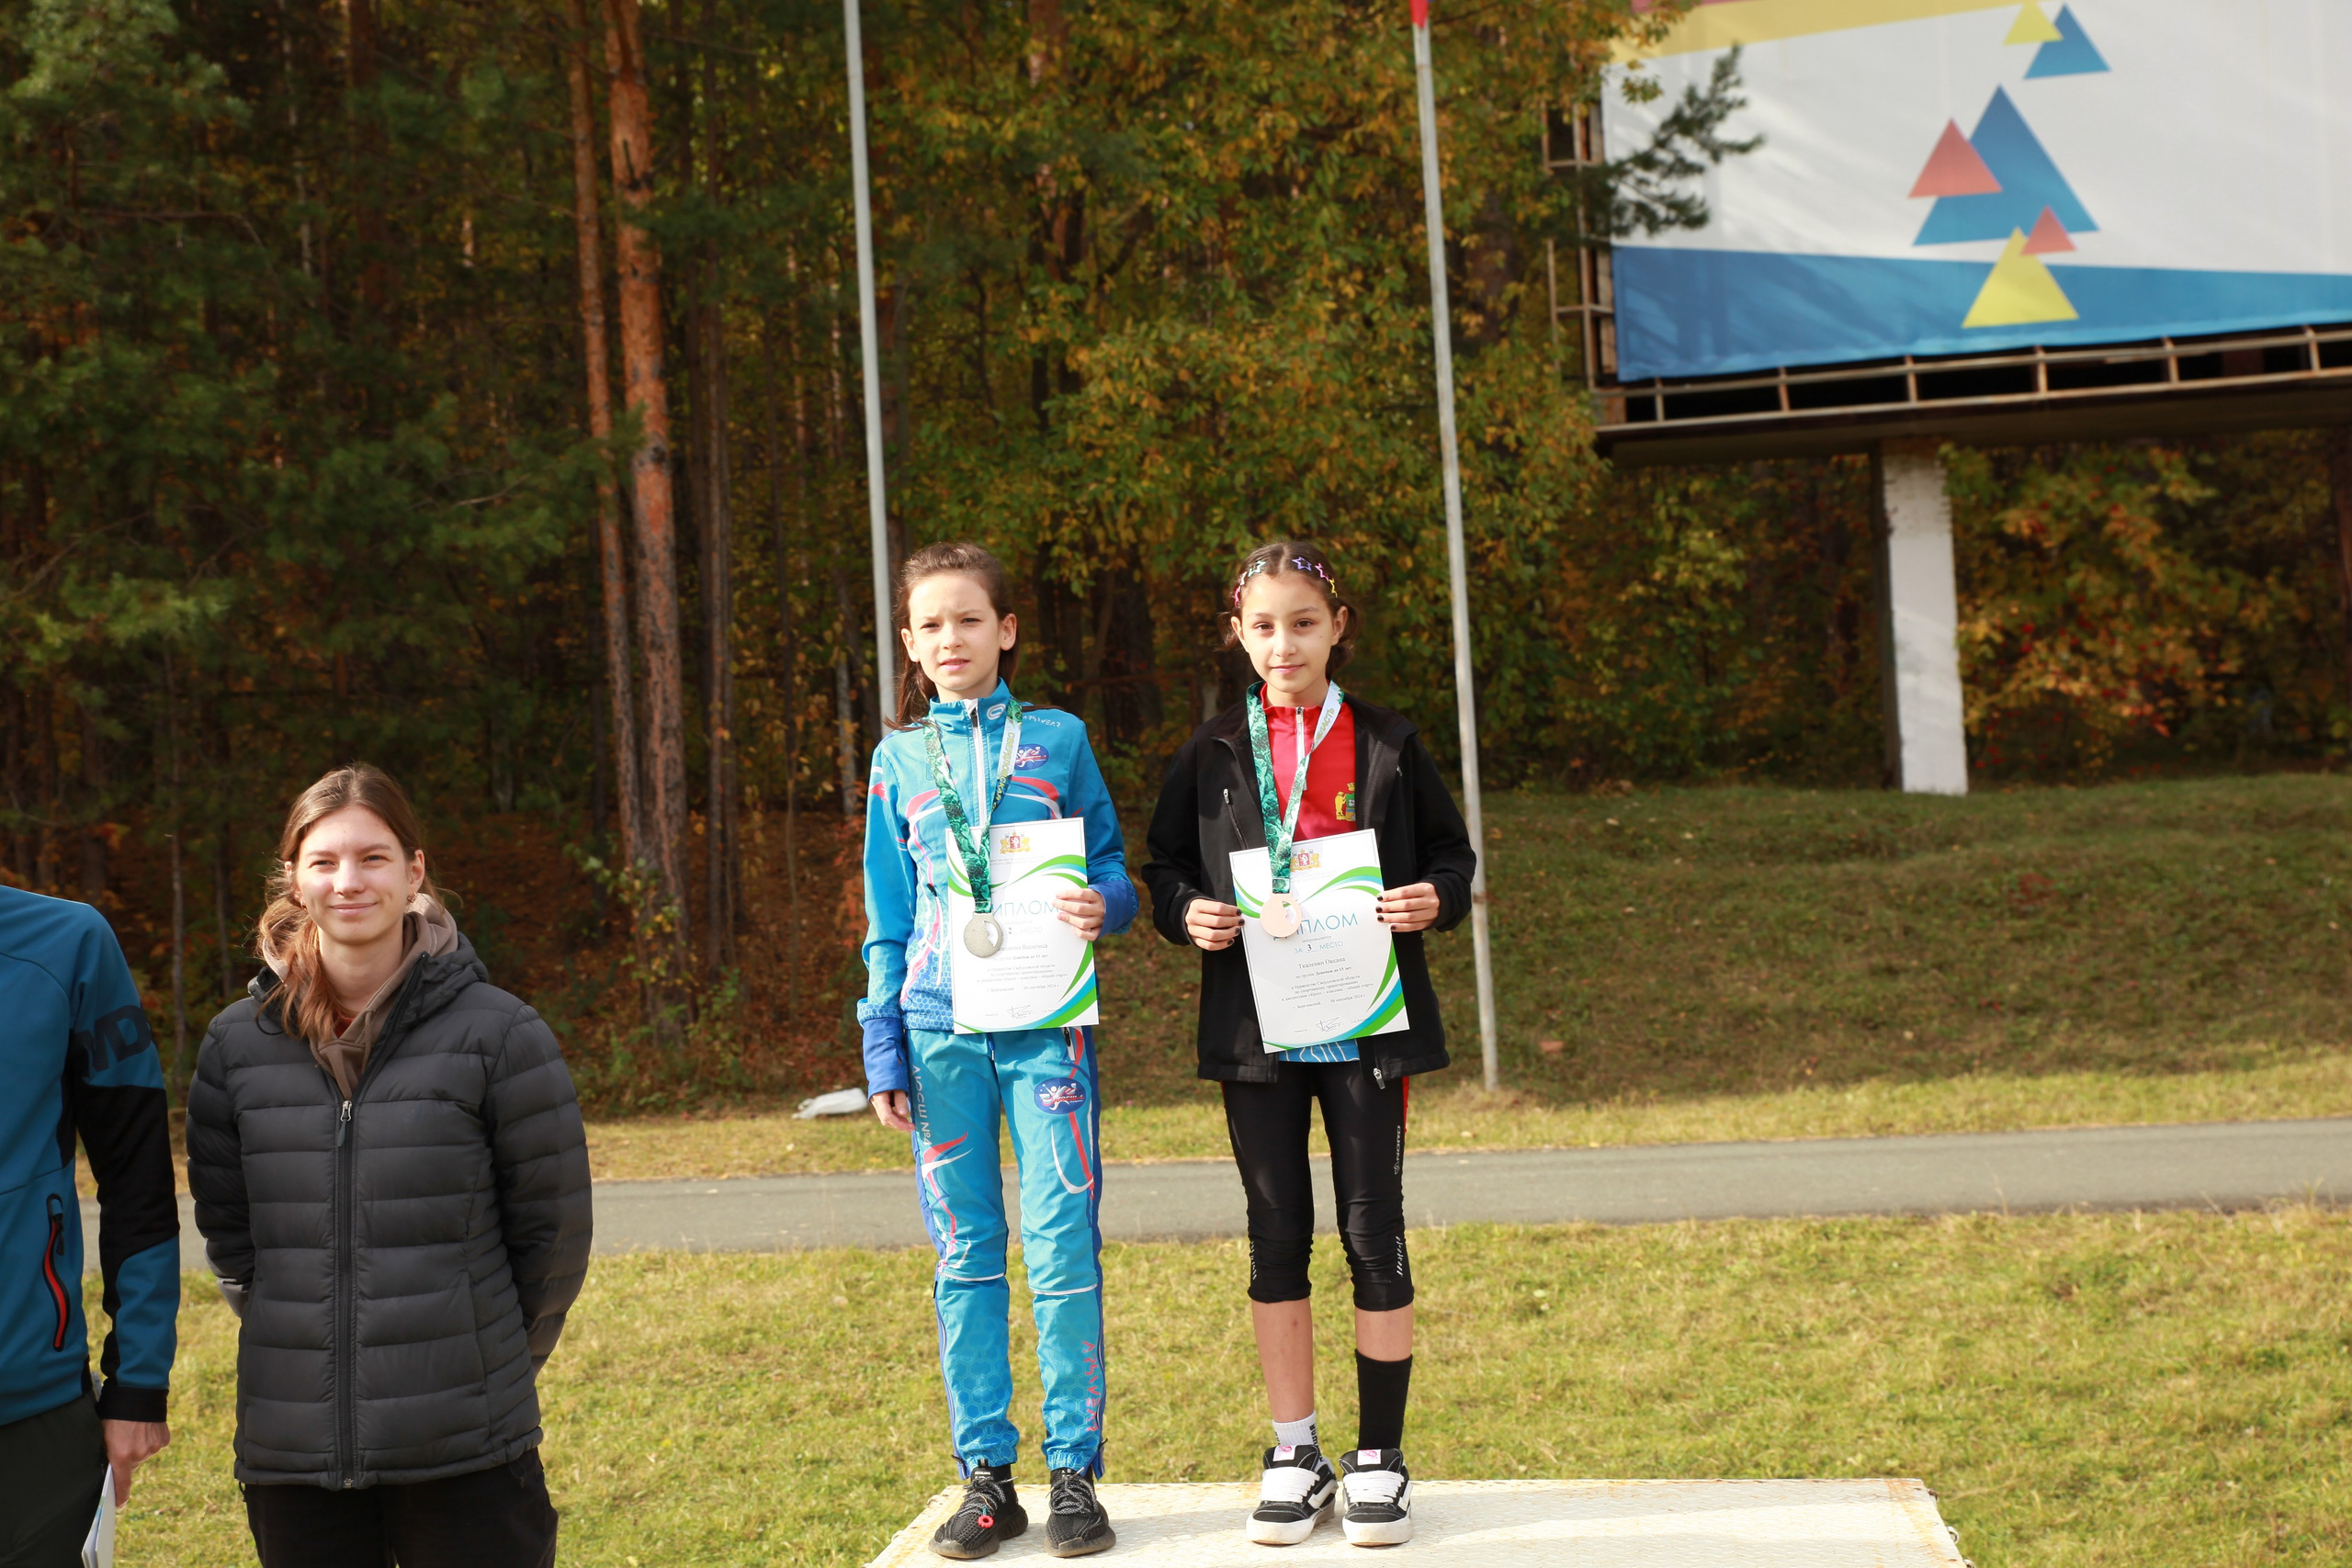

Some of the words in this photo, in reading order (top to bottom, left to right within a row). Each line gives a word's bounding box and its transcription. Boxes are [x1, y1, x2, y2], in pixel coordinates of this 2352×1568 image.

[996, 731, 1016, 802] СВЕРДЛОВСКАЯ
[993, 900, 1058, 917] ИПЛОМ
[1273, 913, 1358, 941] ПЛОМ
[1319, 941, 1344, 950] МЕСТО
[1325, 957, 1346, 965] Оксана
